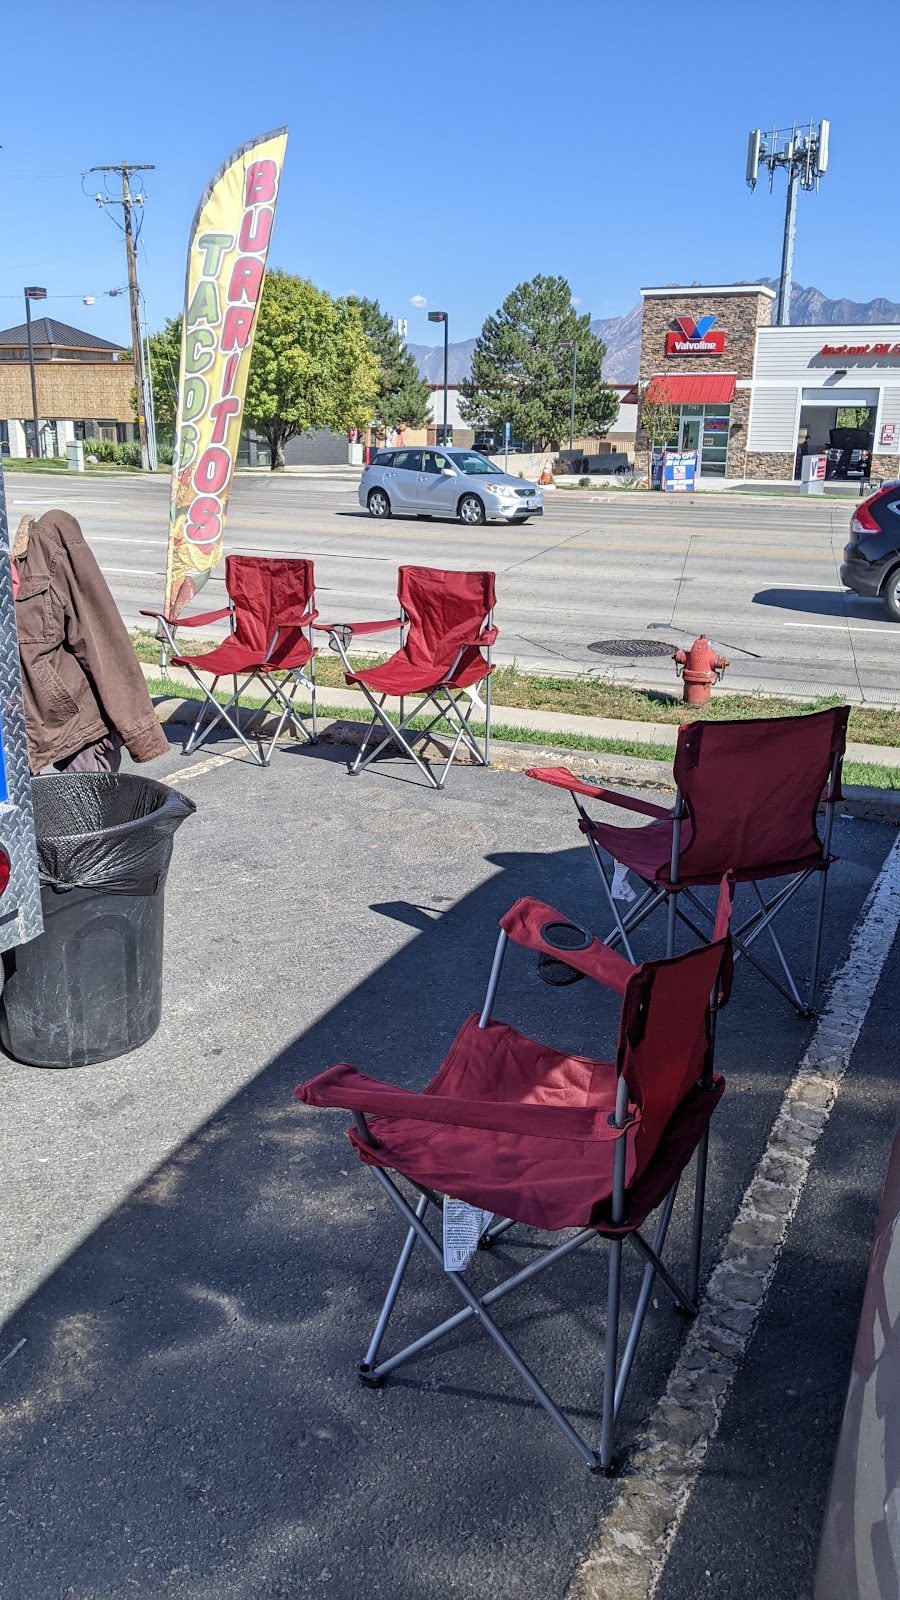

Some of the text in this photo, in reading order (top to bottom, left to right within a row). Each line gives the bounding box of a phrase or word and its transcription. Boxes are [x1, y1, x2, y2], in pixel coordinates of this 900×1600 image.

[184, 158, 280, 544] BURRITOS
[674, 341, 717, 350] Valvoline
[821, 344, 871, 355] Instant
[177, 232, 237, 471] TACOS
[682, 452, 695, 460] OFF
